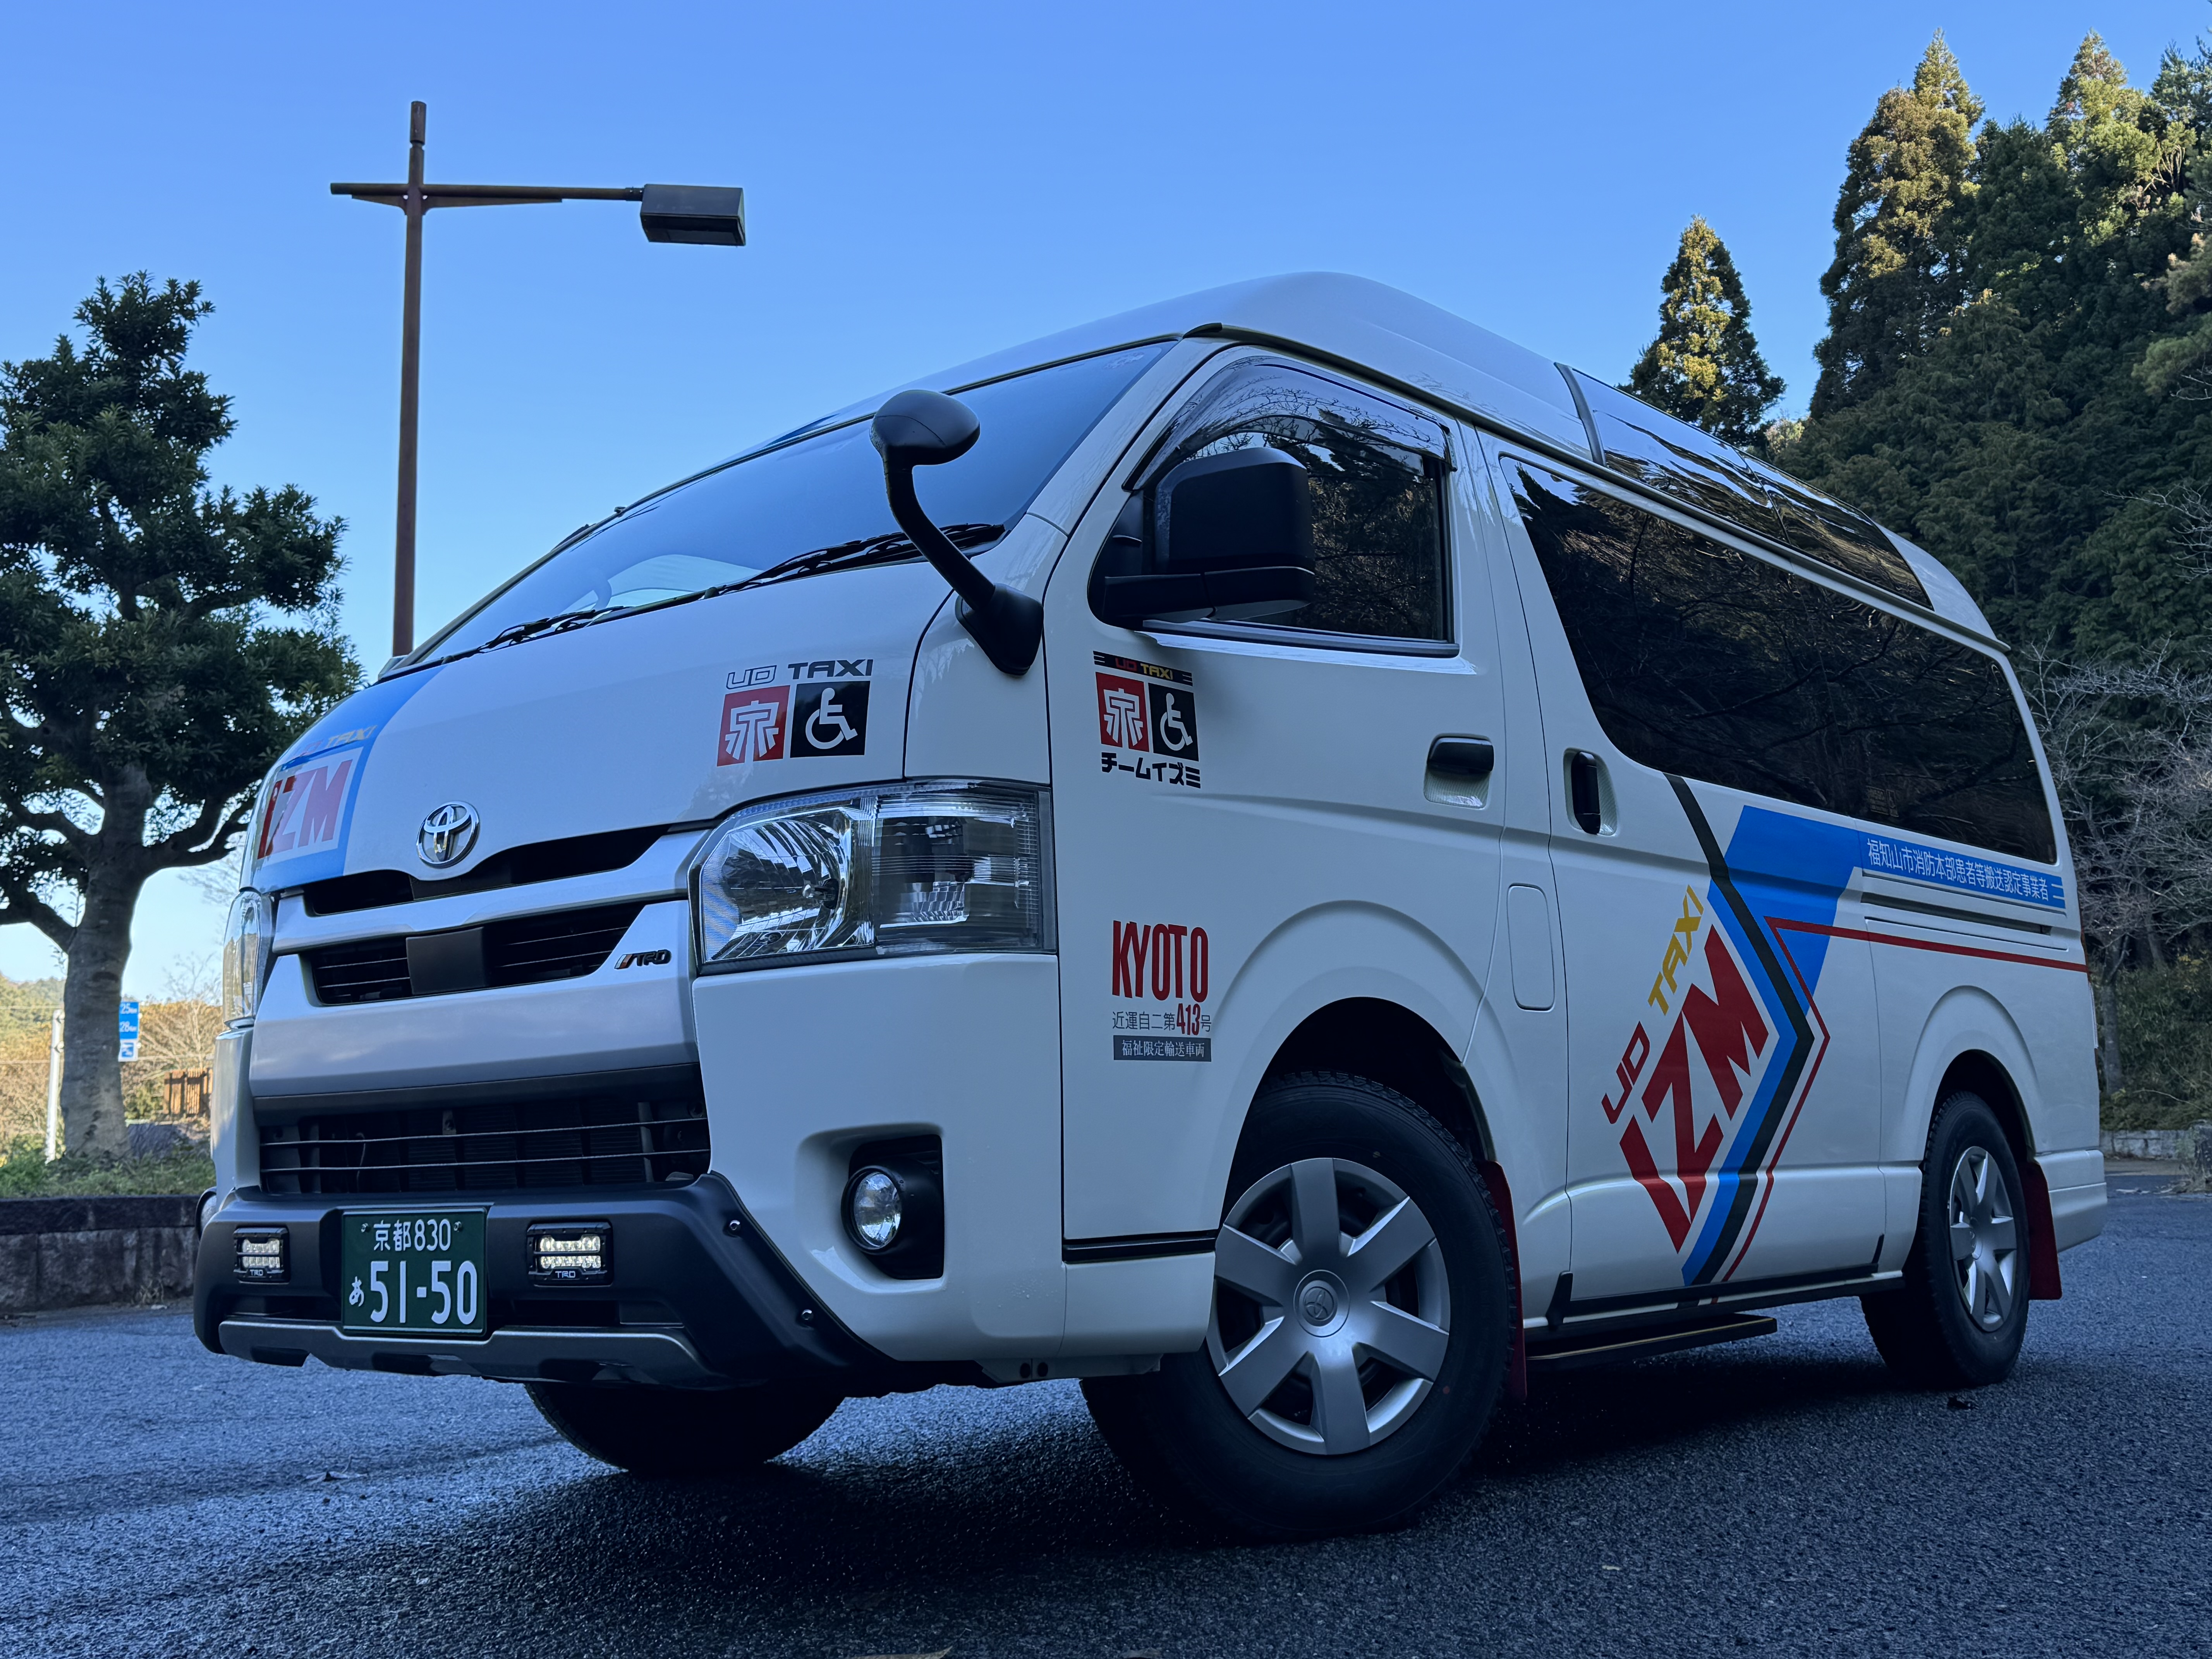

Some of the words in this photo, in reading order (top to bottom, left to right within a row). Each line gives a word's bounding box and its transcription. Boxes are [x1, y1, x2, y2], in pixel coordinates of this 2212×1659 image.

[726, 665, 777, 689] UD
[788, 659, 873, 680] TAXI
[1115, 657, 1137, 672] UD
[1140, 663, 1173, 680] TAXI
[1101, 752, 1201, 789] チームイズミ
[257, 759, 353, 860] IZM
[1867, 838, 2049, 902] 福知山市消防本部患者等搬送認定事業者
[1112, 920, 1209, 1003] KYOTO
[1648, 884, 1704, 1016] TAXI
[1112, 1003, 1212, 1036] 近運自二第413号
[1121, 1039, 1205, 1058] 福祉限定輸送車両
[1620, 924, 1769, 1254] IZM
[370, 1260, 477, 1325] 51-50
